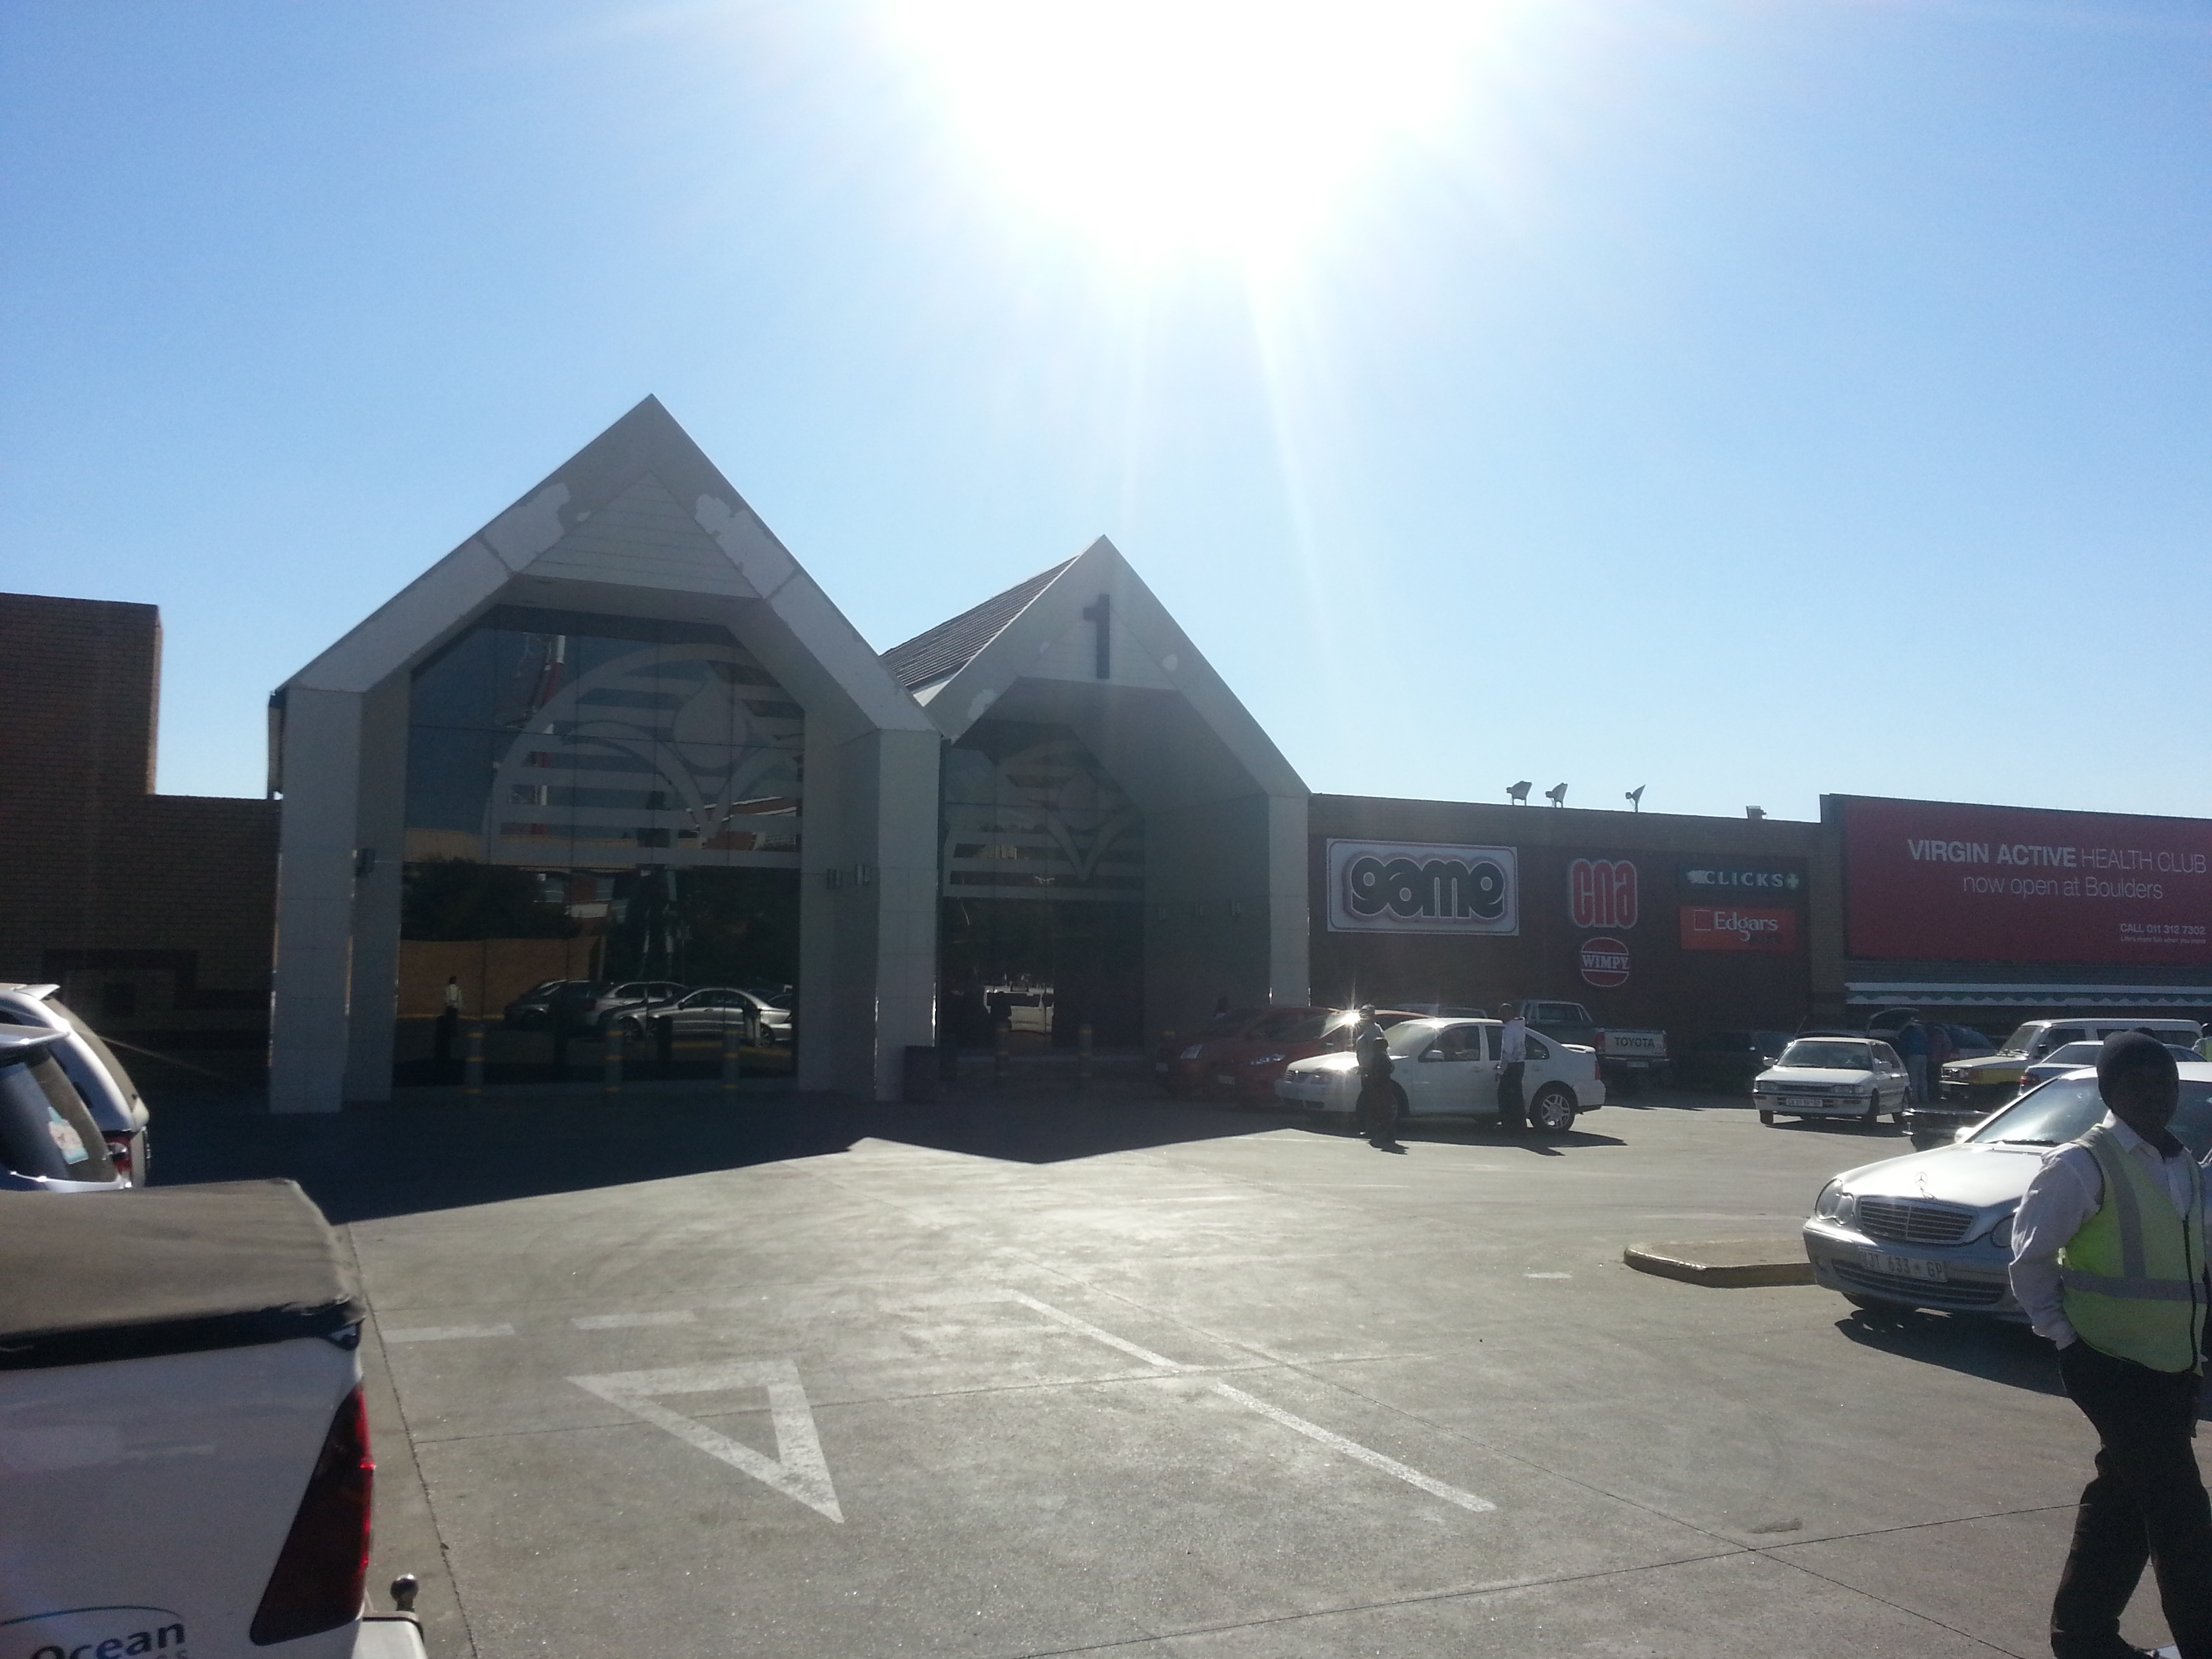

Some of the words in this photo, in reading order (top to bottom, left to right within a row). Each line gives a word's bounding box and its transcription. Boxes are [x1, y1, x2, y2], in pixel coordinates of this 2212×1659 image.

[1083, 594, 1111, 680] 1
[1907, 839, 1990, 863] VIRGIN
[1996, 844, 2077, 867] ACTIVE
[2081, 848, 2153, 870] HEALTH
[2157, 851, 2207, 874] CLUB
[1350, 855, 1506, 919] game
[1705, 870, 1784, 888] CLICKS
[1963, 876, 2005, 893] now
[2010, 878, 2059, 899] open
[2064, 877, 2081, 896] at
[2085, 876, 2163, 899] Boulders
[1714, 911, 1779, 942] Edgars
[2121, 923, 2145, 933] CALL
[2146, 924, 2161, 934] 011
[2163, 924, 2180, 935] 312
[2182, 925, 2207, 935] 7302
[1582, 954, 1629, 970] WIMPY
[1614, 1037, 1654, 1047] TOYOTA
[1927, 1261, 1943, 1277] GP
